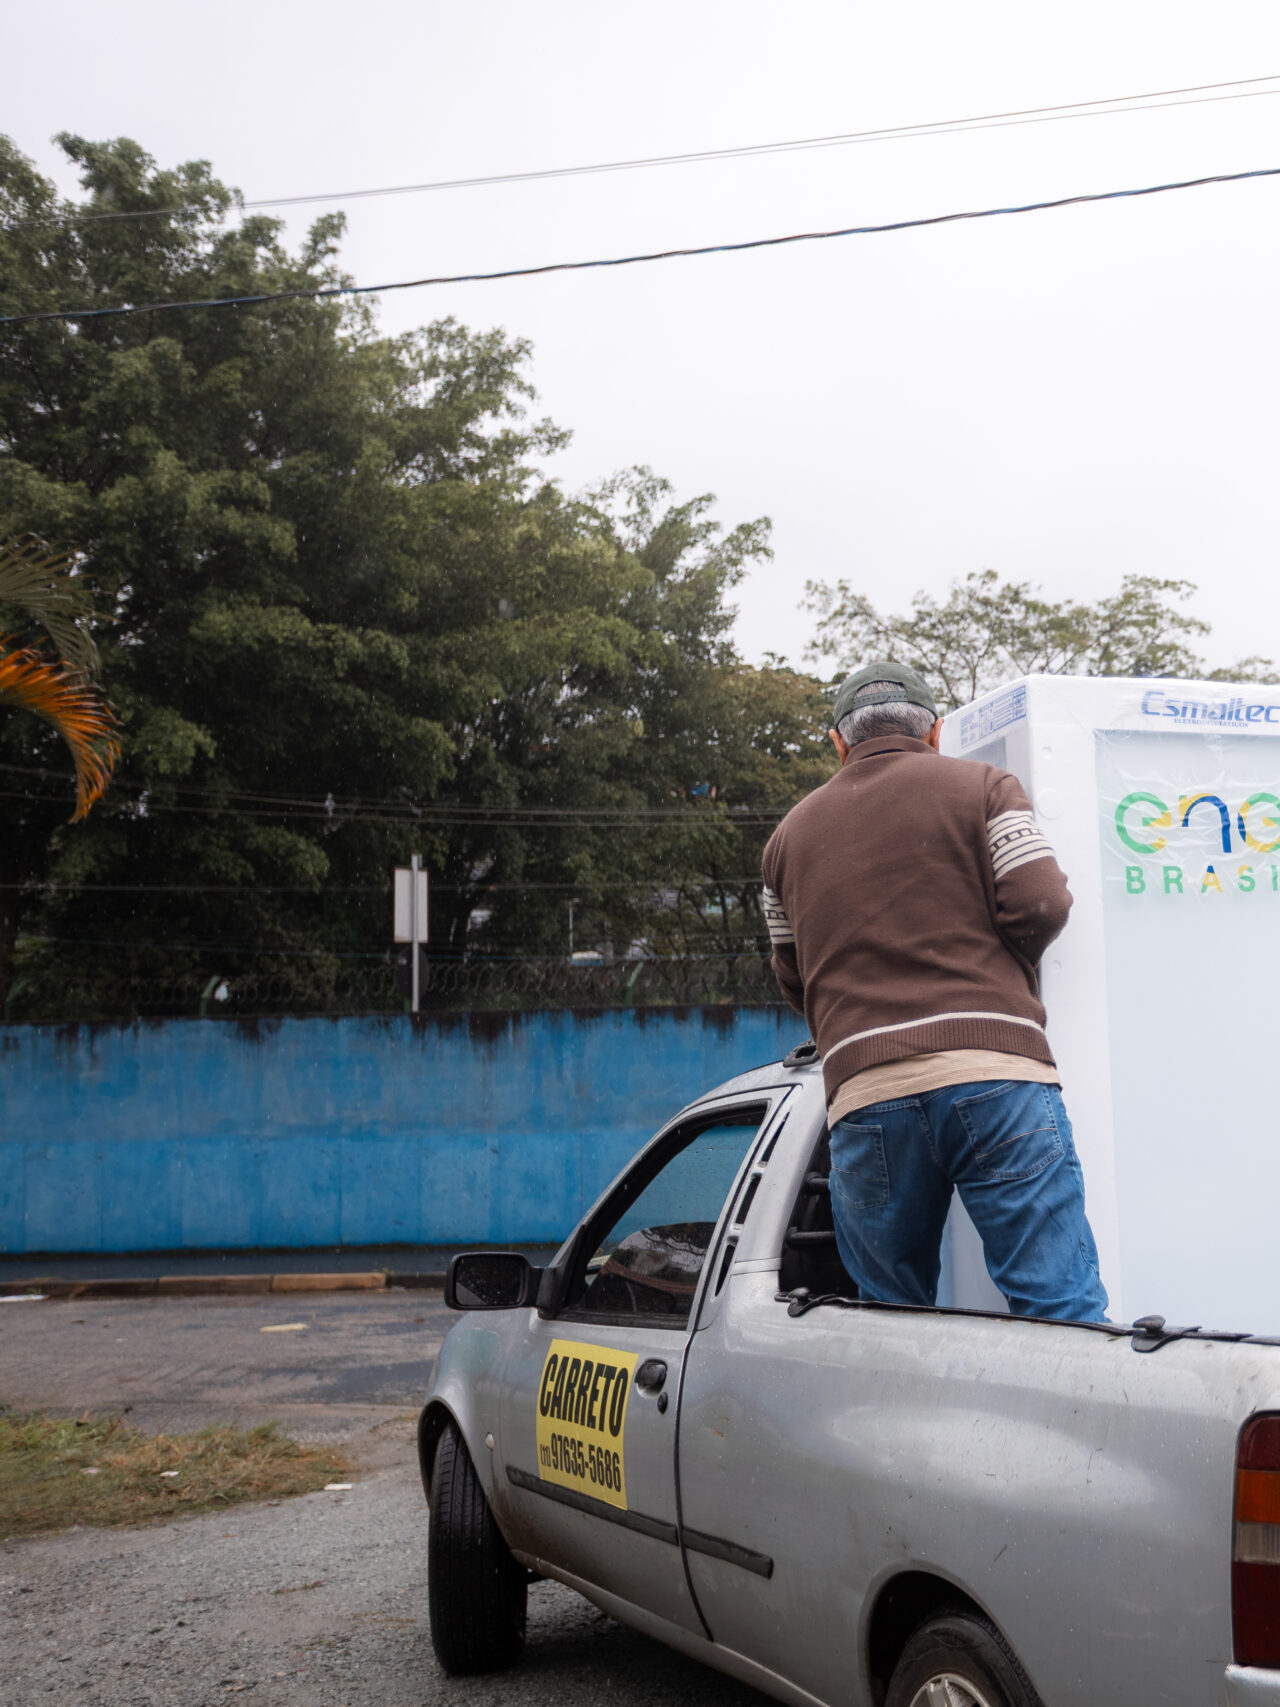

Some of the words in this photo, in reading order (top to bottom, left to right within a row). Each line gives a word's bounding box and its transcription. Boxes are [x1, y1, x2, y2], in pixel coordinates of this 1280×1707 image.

[1141, 691, 1280, 723] Esmaltec
[540, 1353, 629, 1437] CARRETO
[551, 1433, 621, 1492] 97635-5686
